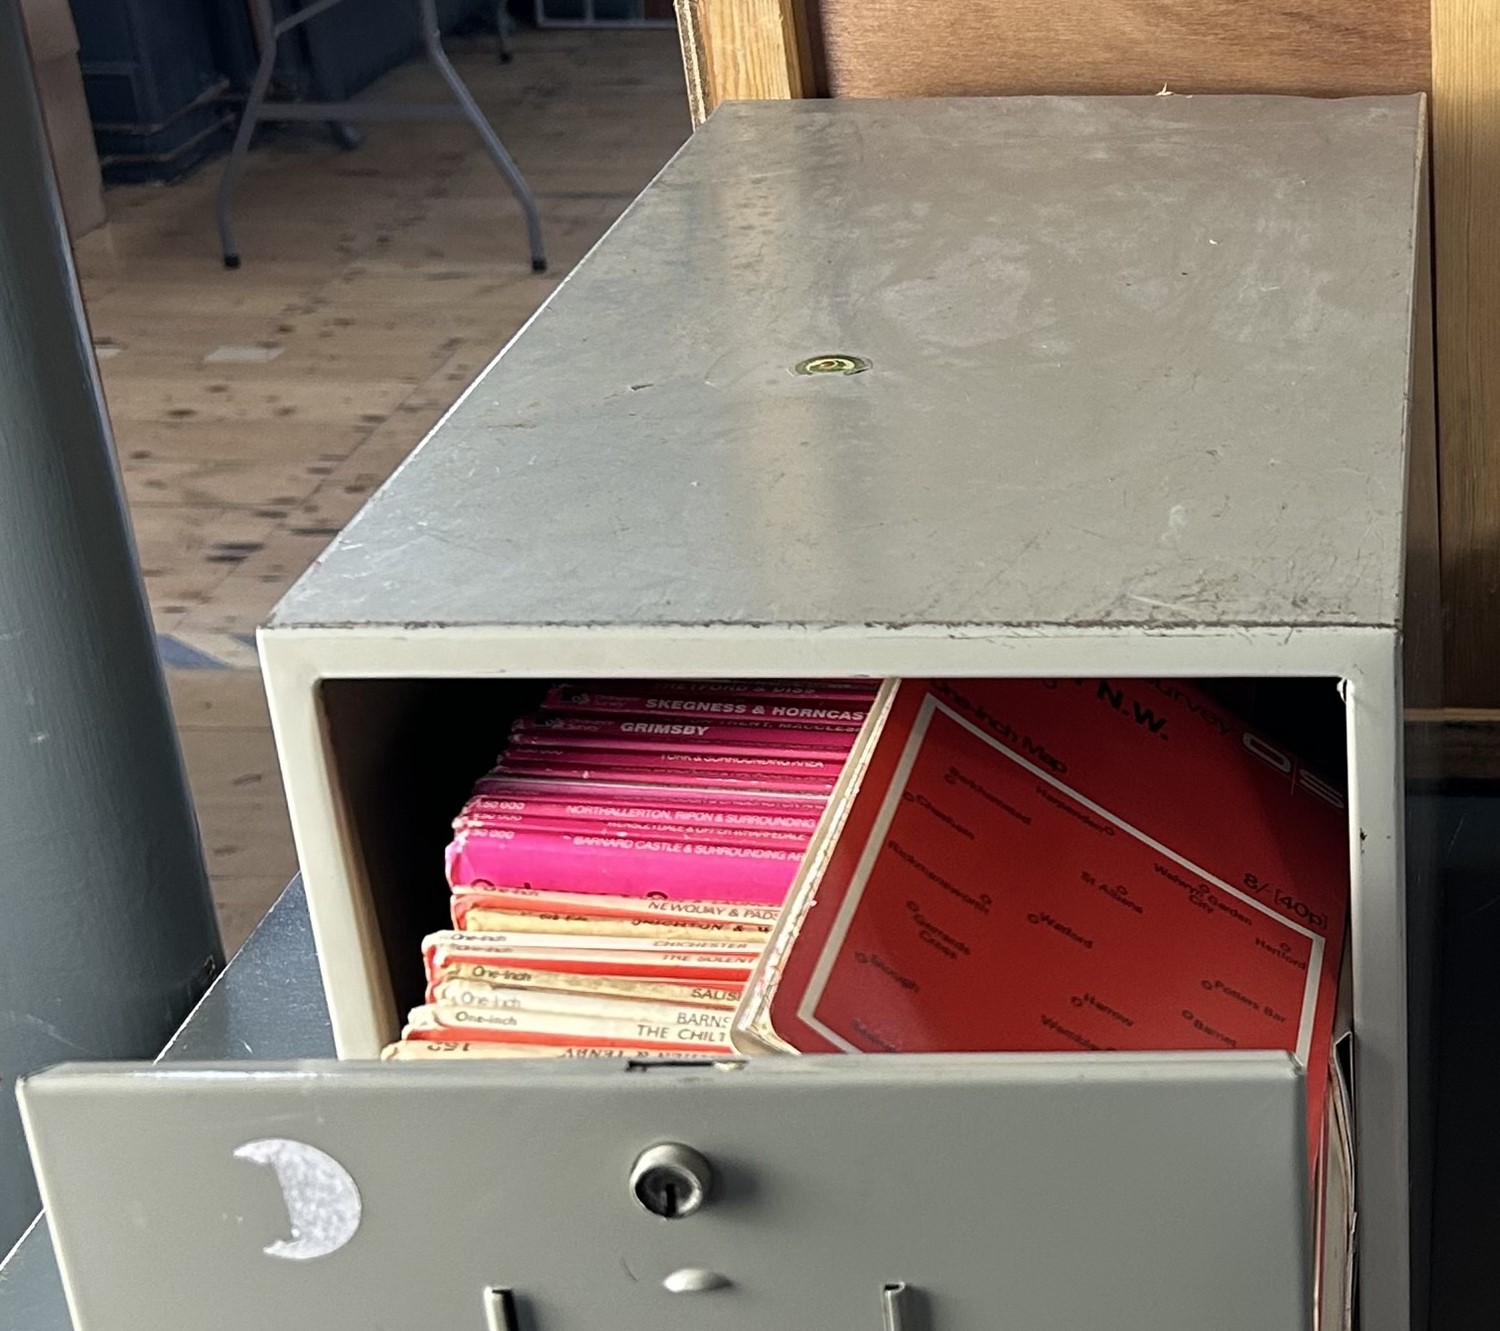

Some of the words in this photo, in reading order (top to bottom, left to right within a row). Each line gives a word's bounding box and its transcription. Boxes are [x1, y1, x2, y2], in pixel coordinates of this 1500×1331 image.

[645, 699, 746, 714] SKEGNESS
[752, 705, 765, 715] &
[772, 706, 869, 721] HORNCAS
[620, 722, 710, 736] GRIMSBY
[649, 901, 726, 917] NEWQUAY
[456, 1011, 517, 1026] One-inch
[637, 1025, 668, 1039] THE
